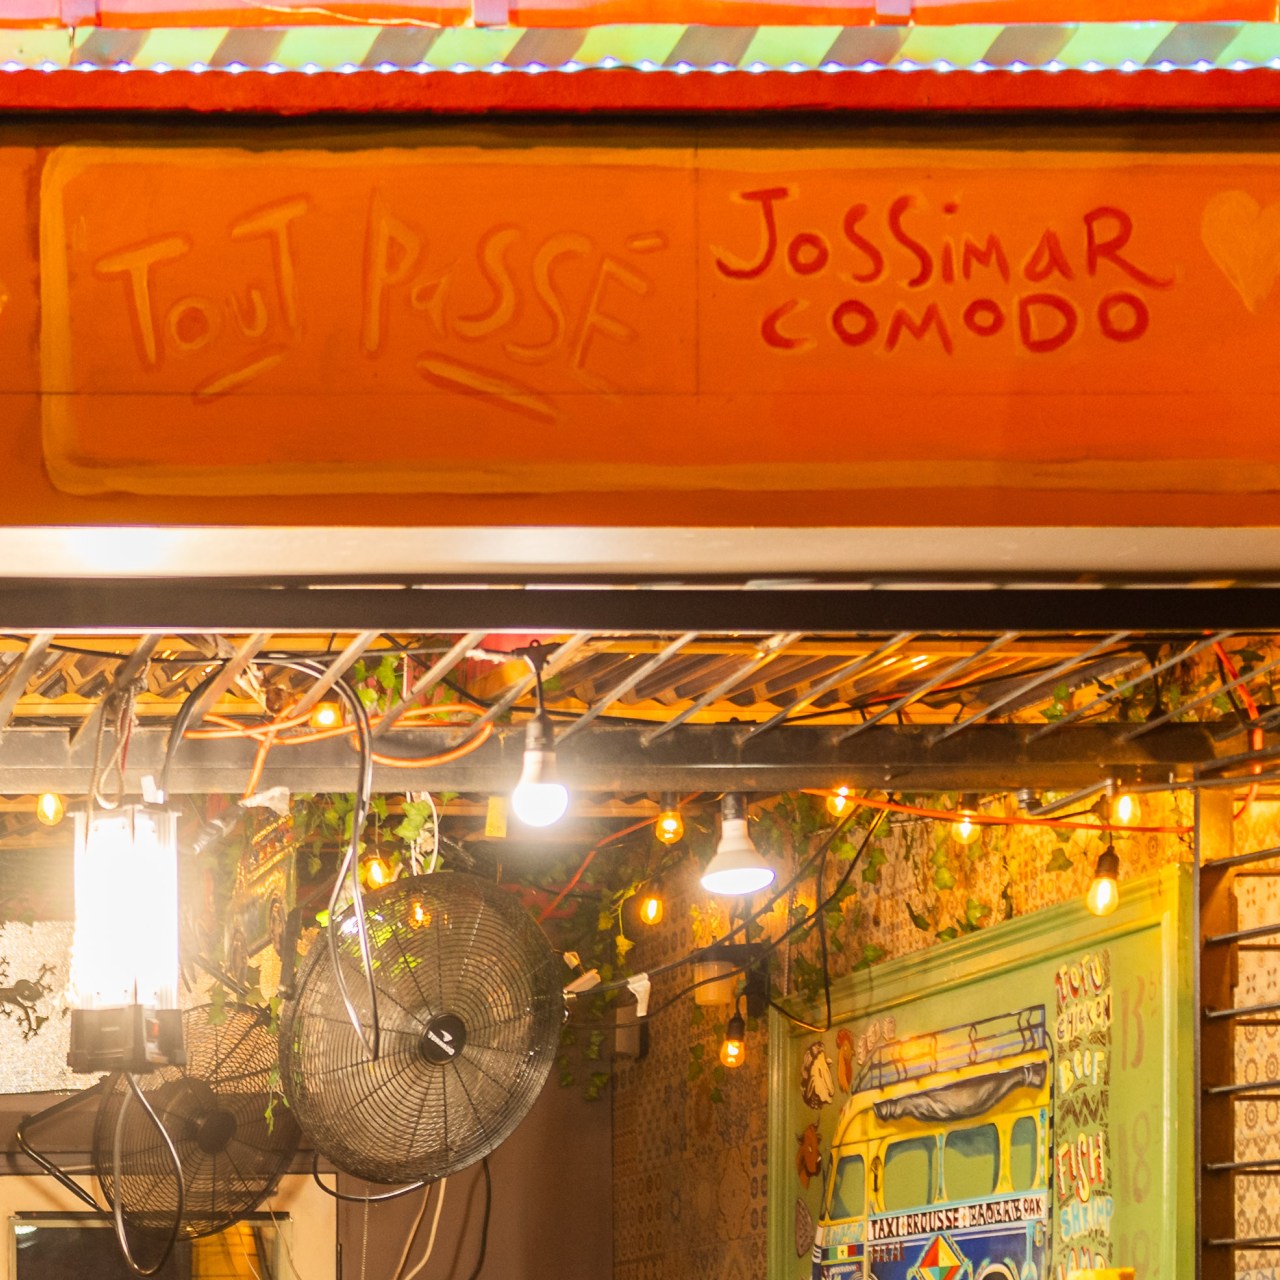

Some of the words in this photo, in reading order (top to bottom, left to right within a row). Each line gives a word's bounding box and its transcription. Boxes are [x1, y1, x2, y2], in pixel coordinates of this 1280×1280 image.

[758, 291, 1152, 357] COMODO
[1055, 954, 1104, 1006] TOFU
[1056, 1131, 1105, 1202] FISH
[870, 1215, 901, 1240] TAXI
[905, 1206, 960, 1236] BROUSSE
[968, 1198, 1022, 1228] BAOBAB
[1060, 1195, 1114, 1242] SHRIMP
